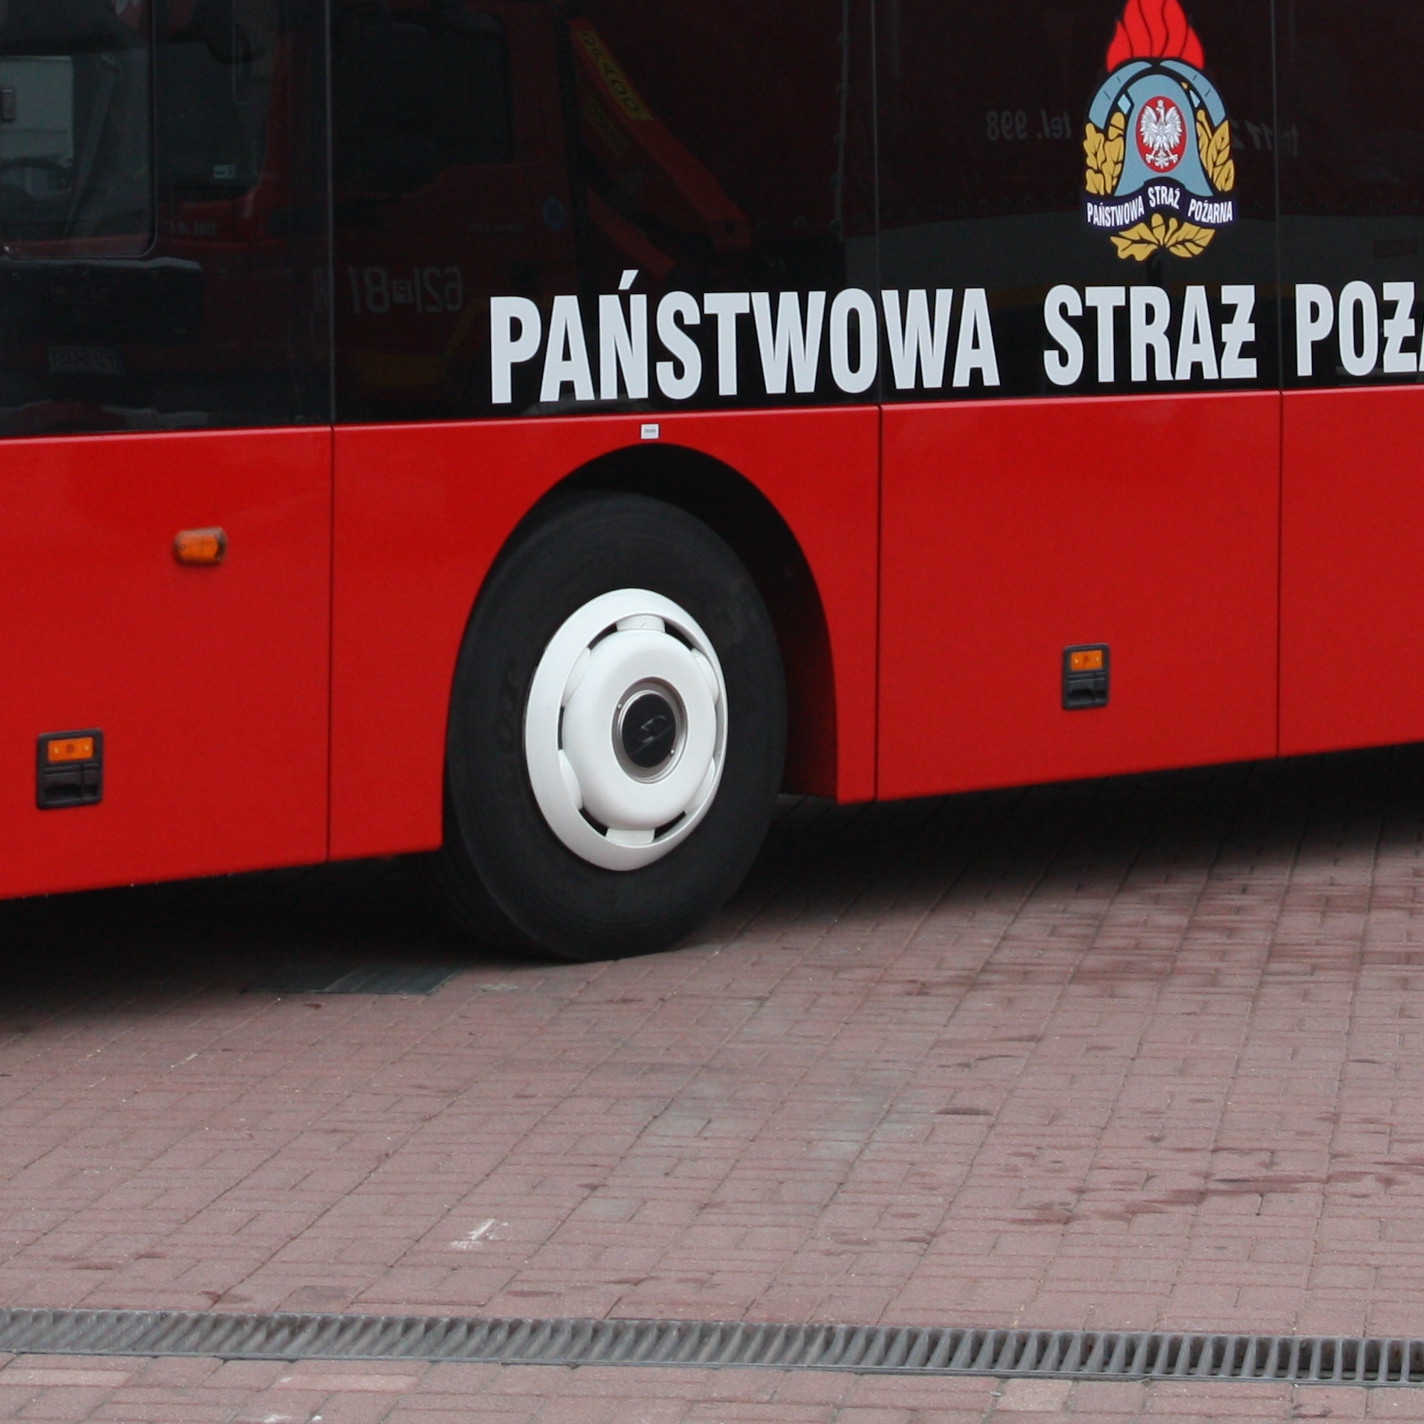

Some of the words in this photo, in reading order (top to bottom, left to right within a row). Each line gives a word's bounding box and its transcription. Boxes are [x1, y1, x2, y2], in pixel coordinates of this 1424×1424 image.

[1086, 195, 1145, 227] PAŃSTWOWA
[1147, 185, 1181, 210] STRAŻ
[1187, 198, 1233, 224] POŻARNA
[489, 269, 1001, 404] PAŃSTWOWA
[1043, 284, 1258, 386] STRAŻ
